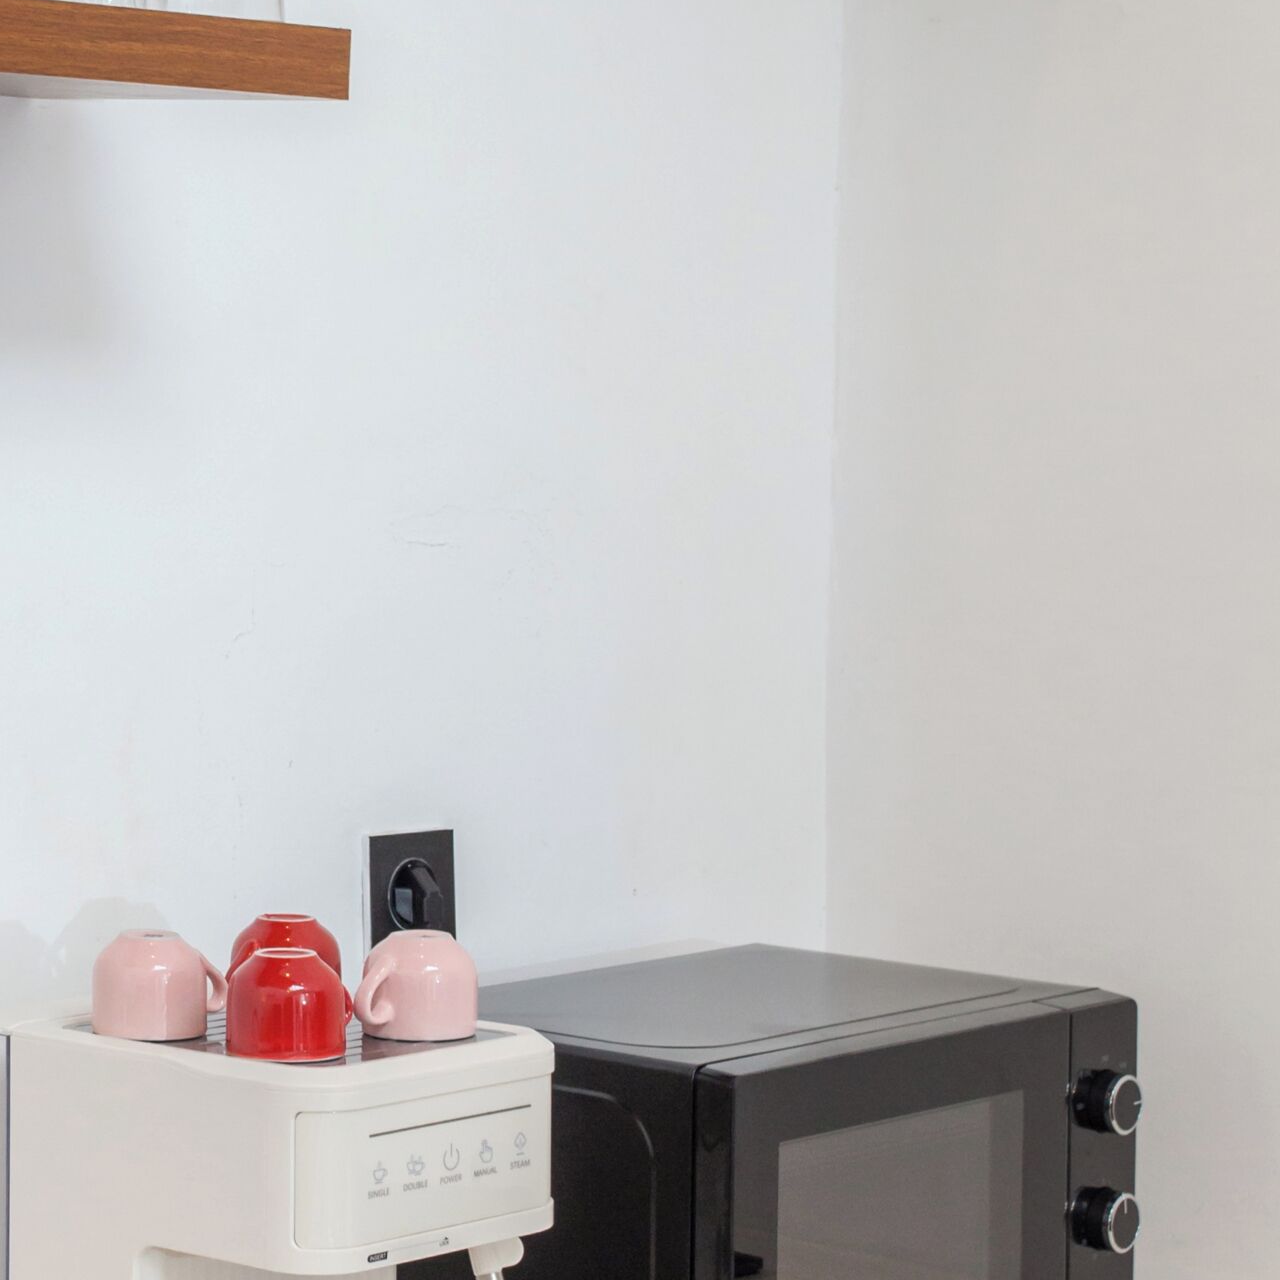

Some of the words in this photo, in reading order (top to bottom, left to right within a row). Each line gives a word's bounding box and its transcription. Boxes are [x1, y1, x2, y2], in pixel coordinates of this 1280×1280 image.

[509, 1159, 531, 1170] STEAM
[473, 1167, 498, 1178] MANUAL
[439, 1173, 462, 1185] POWER
[402, 1179, 428, 1192] DOUBLE
[368, 1187, 390, 1199] SINGLE
[369, 1252, 387, 1262] INSERT
